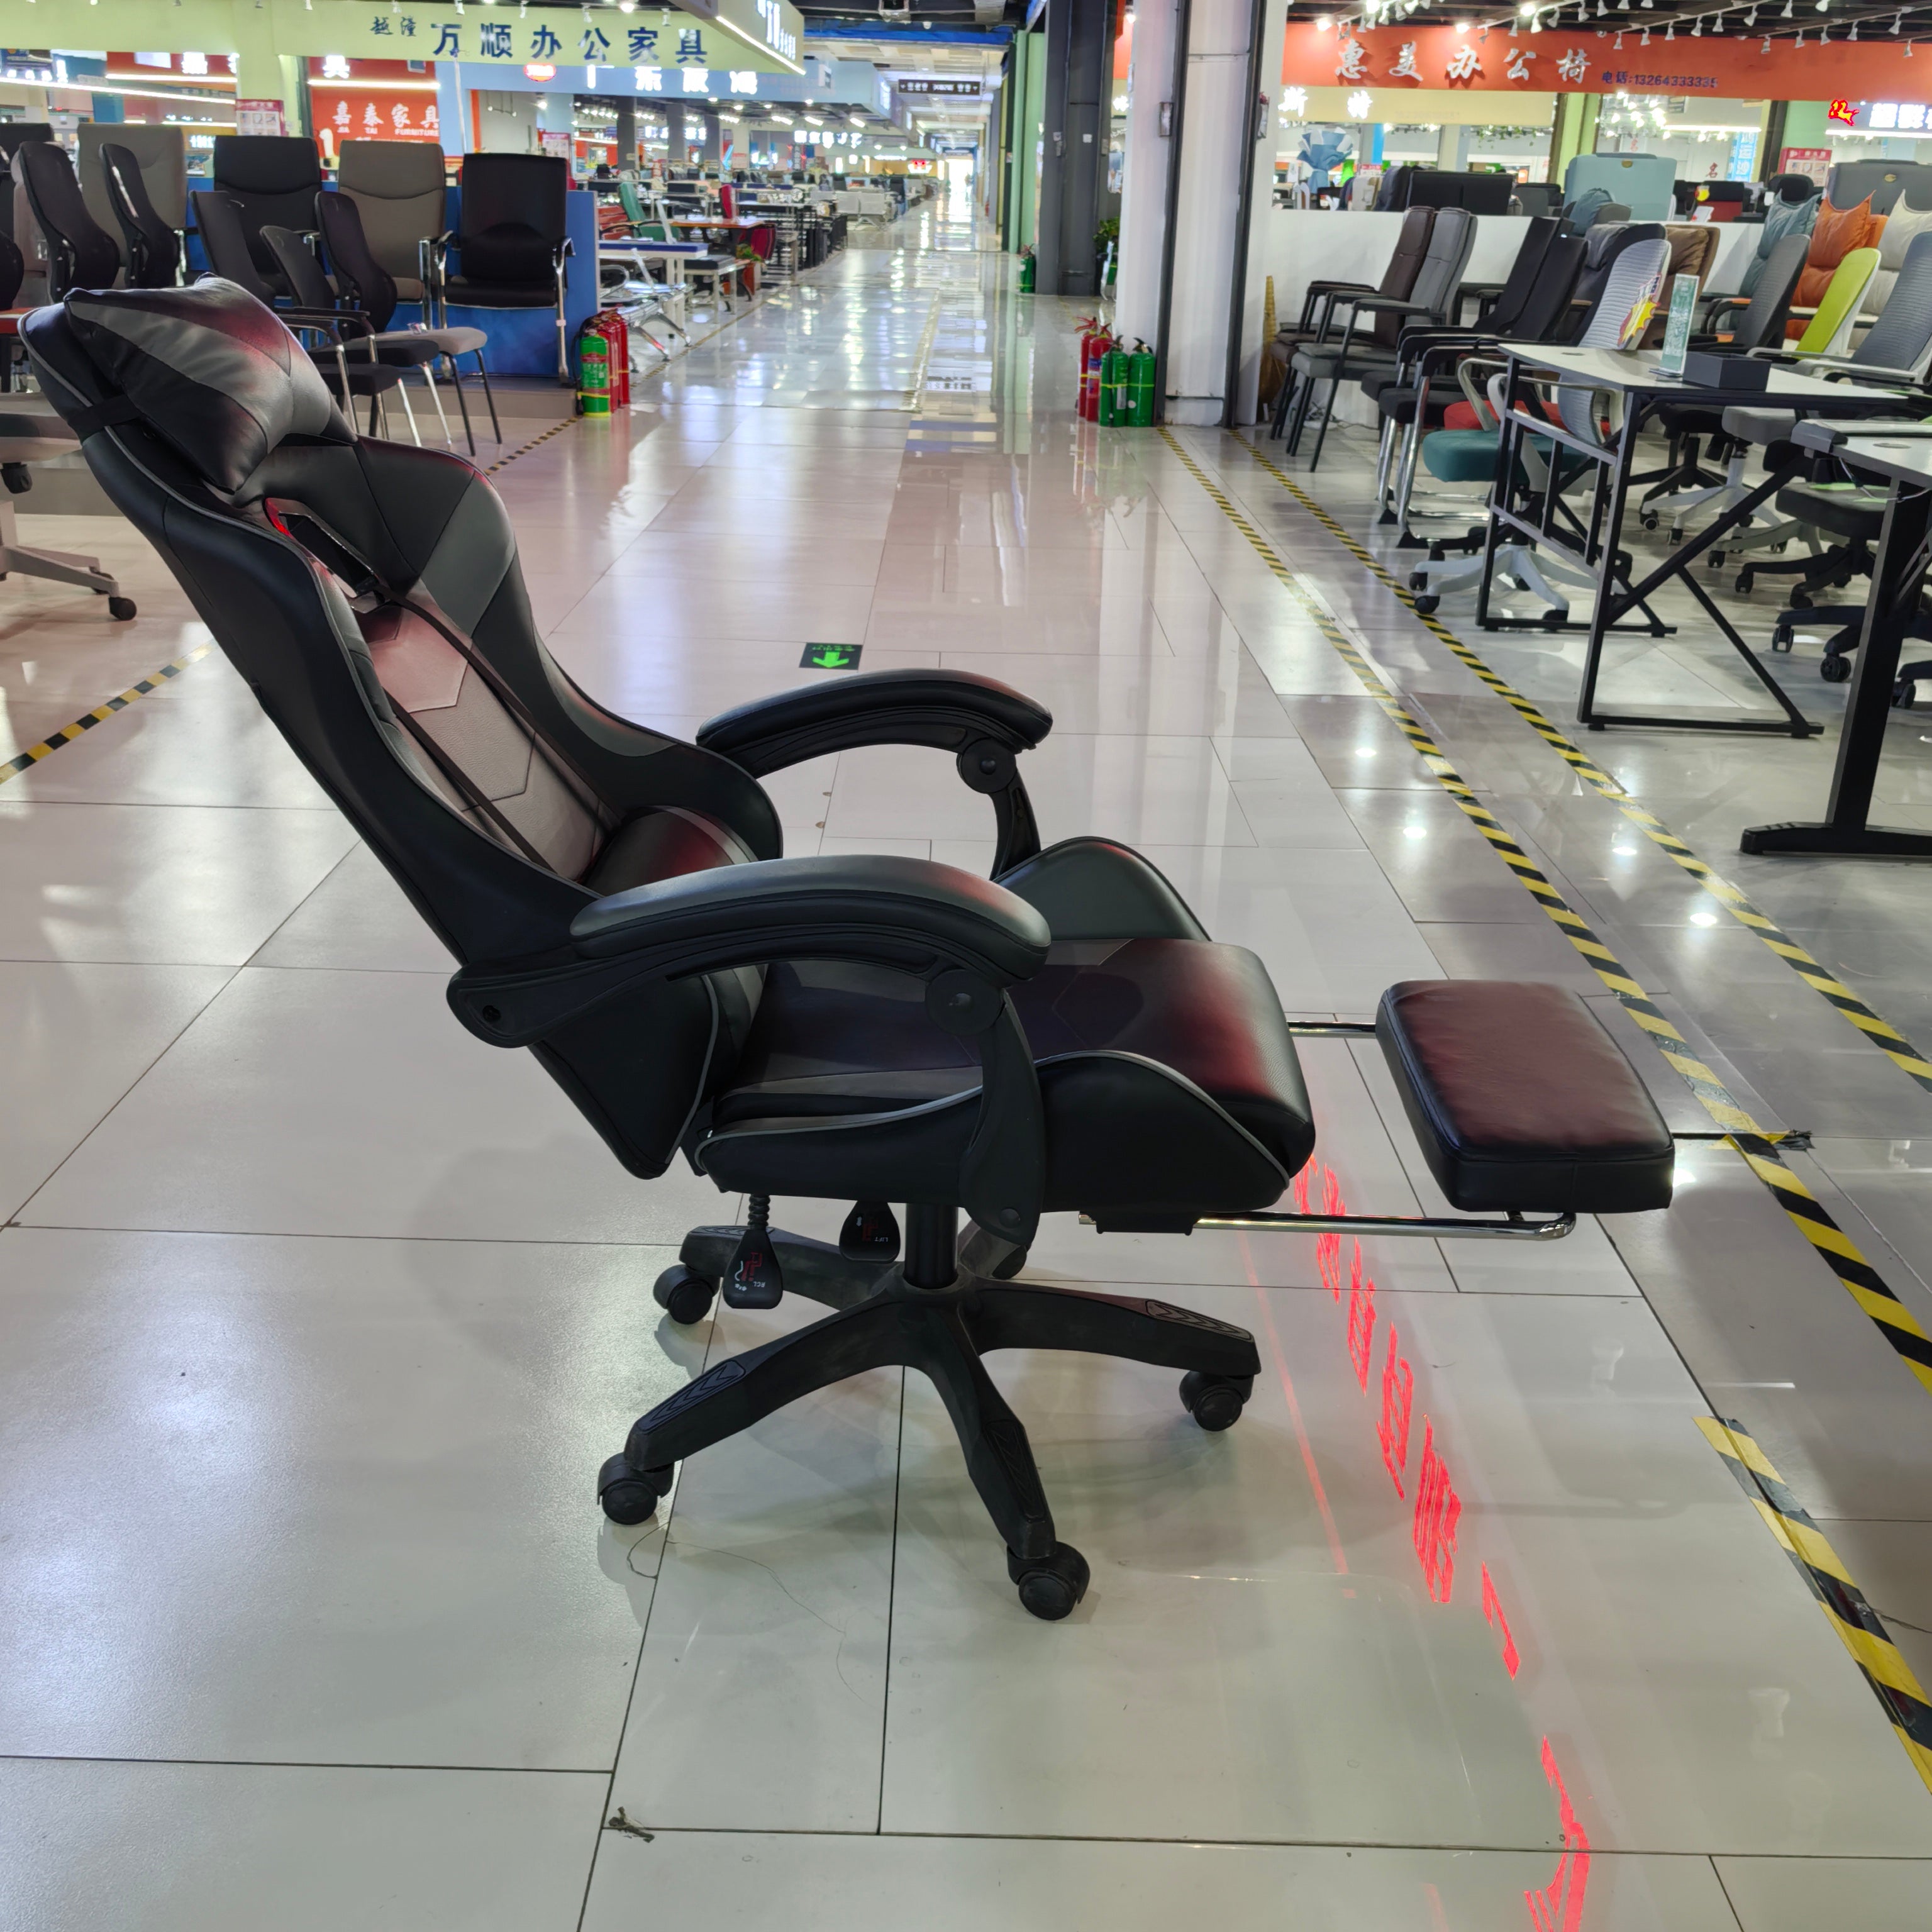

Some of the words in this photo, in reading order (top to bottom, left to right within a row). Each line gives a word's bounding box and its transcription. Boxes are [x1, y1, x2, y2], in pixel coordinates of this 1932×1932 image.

[431, 23, 708, 64] 万顺办公家具
[1336, 39, 1591, 84] 惠美办公椅
[332, 101, 439, 128] 嘉泰家具
